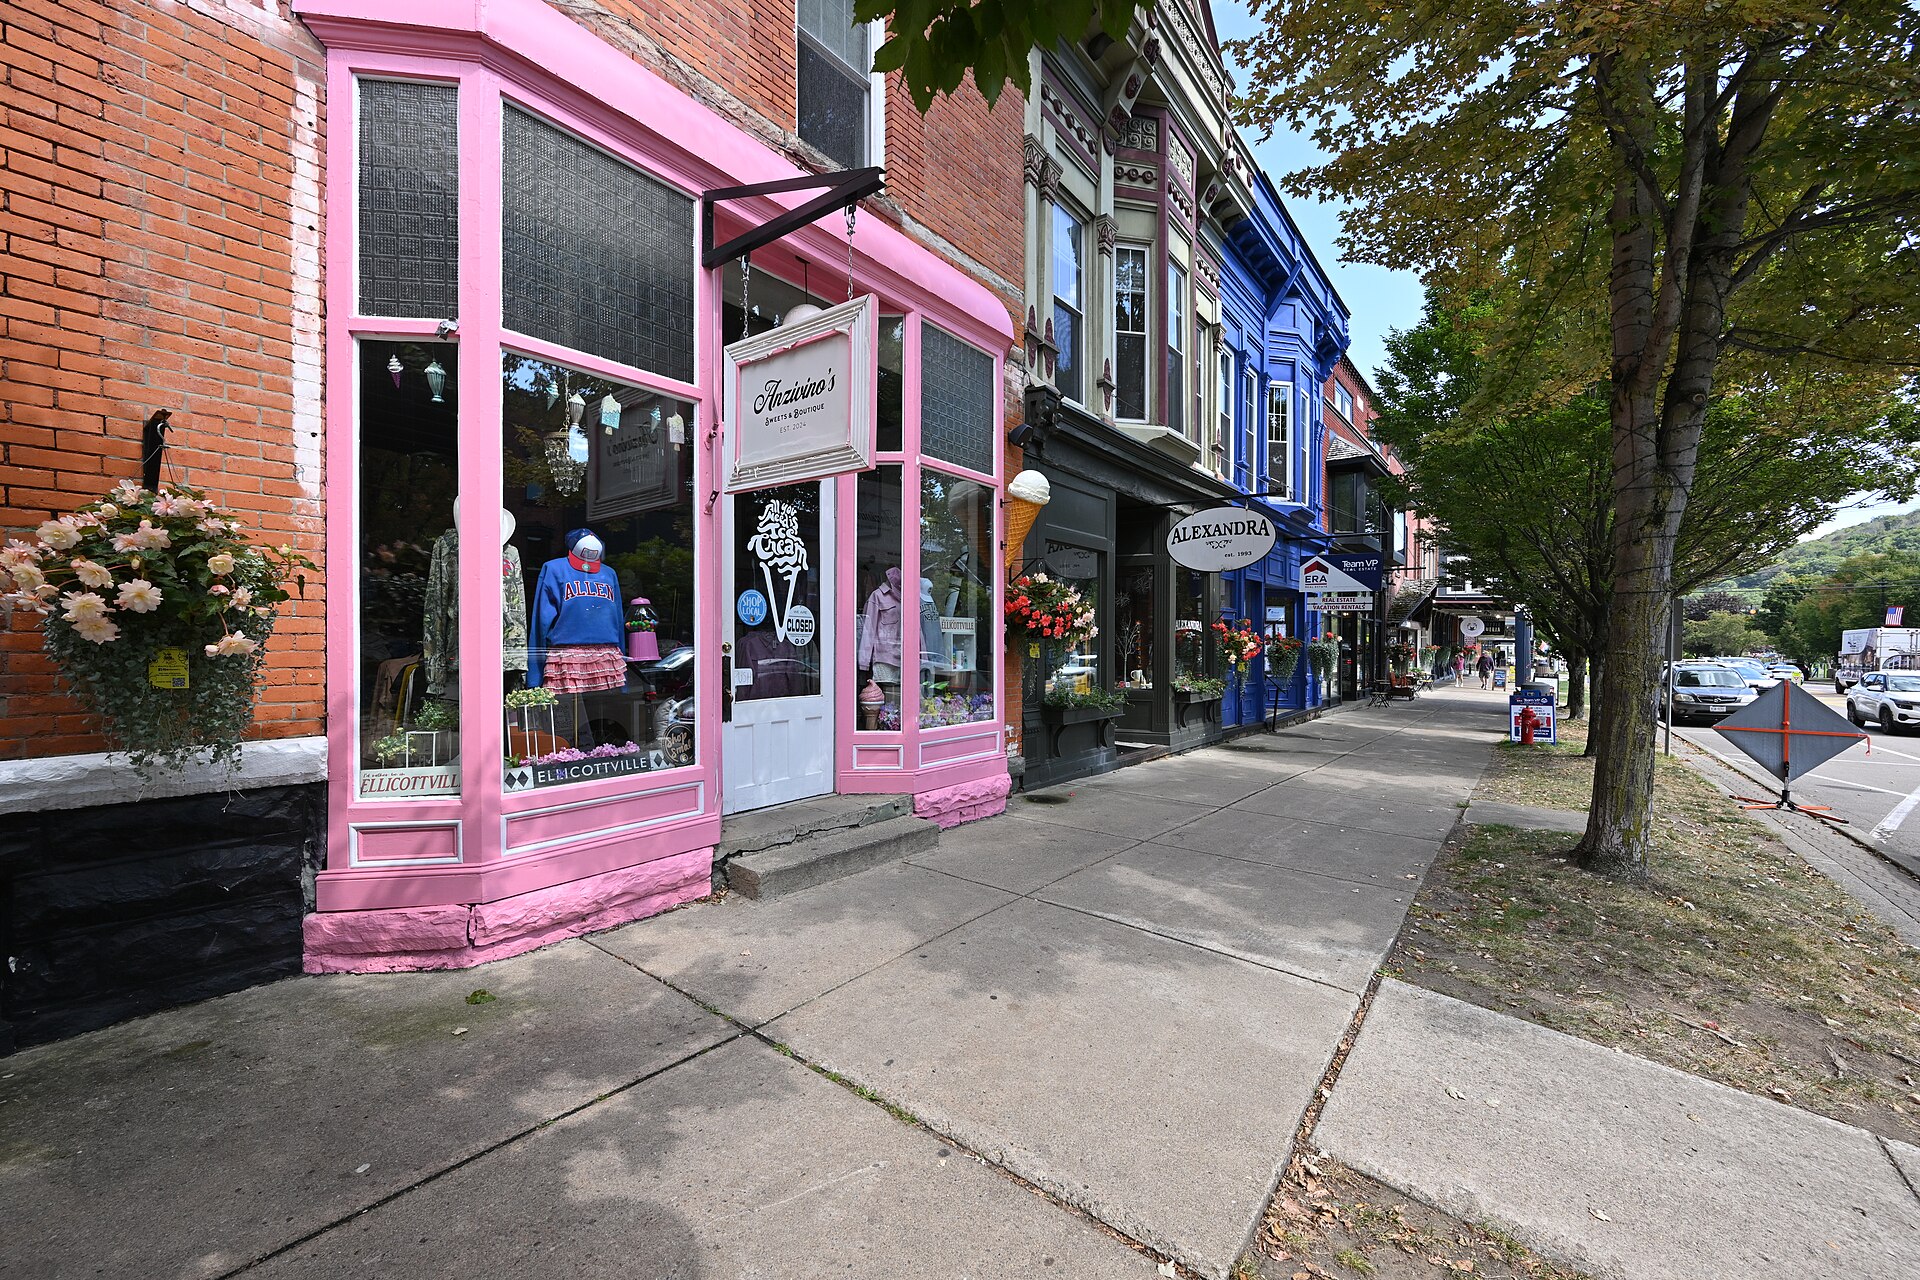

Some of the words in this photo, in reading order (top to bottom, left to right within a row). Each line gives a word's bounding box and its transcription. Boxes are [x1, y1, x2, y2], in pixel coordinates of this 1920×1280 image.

[753, 367, 836, 415] Anzivino's
[1171, 519, 1270, 545] ALEXANDRA
[1342, 560, 1364, 568] Team
[1365, 559, 1379, 567] VP
[1304, 575, 1327, 583] ERA
[564, 580, 615, 603] ALLEN
[742, 596, 762, 607] SHOP
[742, 606, 762, 616] LOCAL
[786, 618, 813, 633] CLOSED
[361, 773, 461, 793] ELLICOTTVILL
